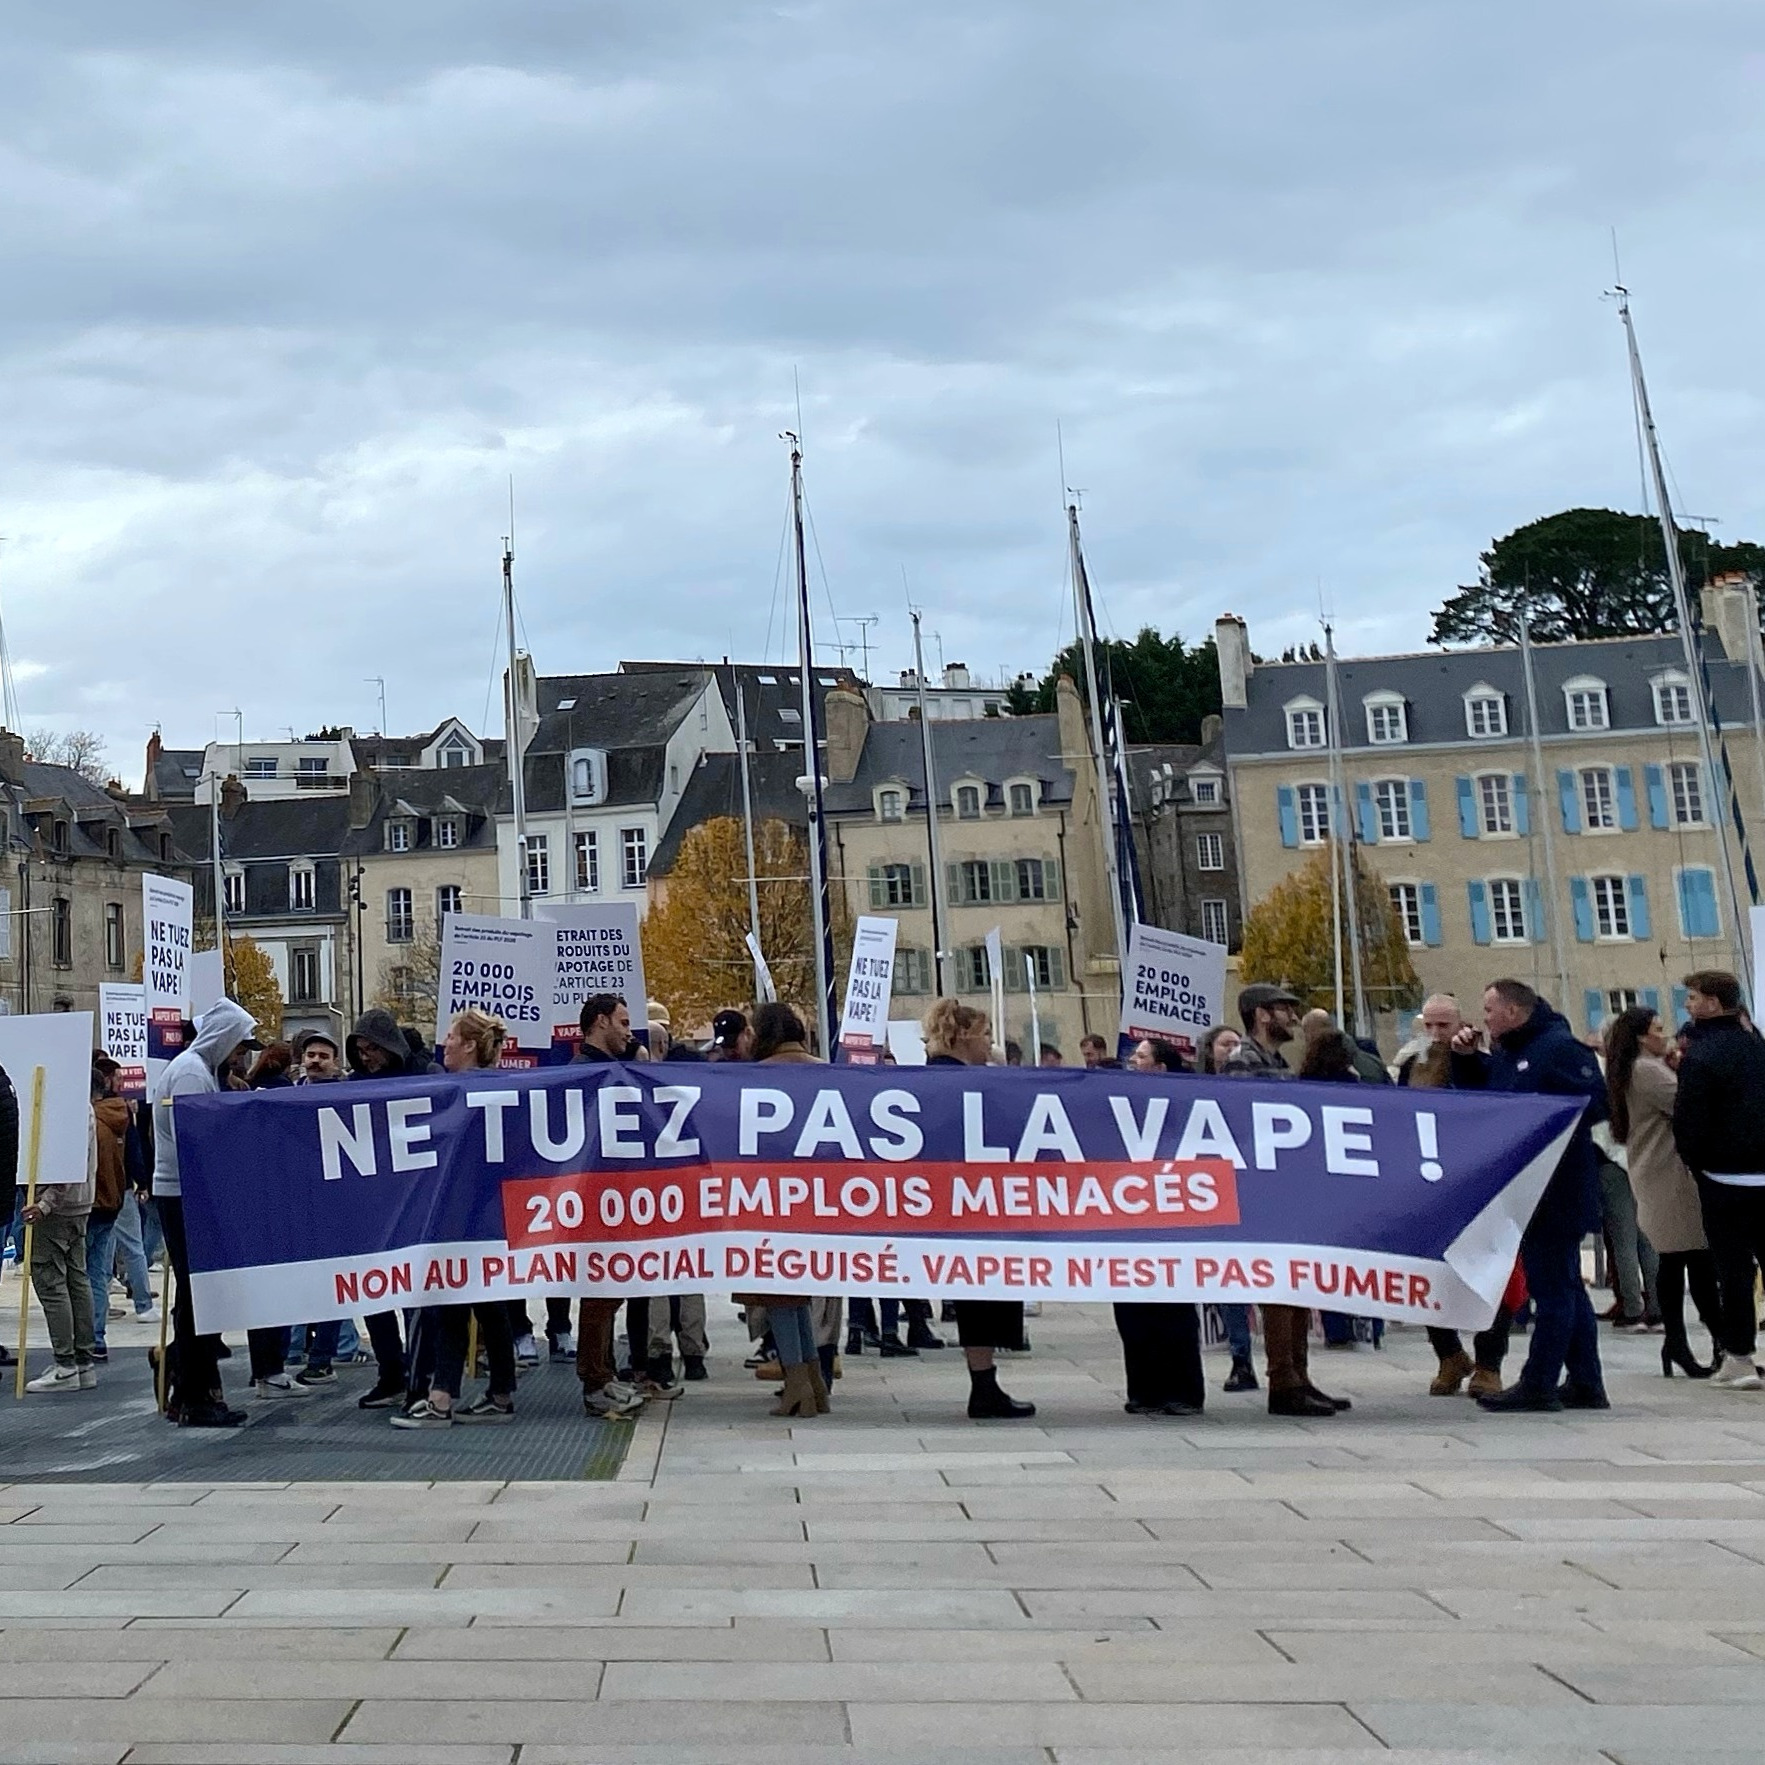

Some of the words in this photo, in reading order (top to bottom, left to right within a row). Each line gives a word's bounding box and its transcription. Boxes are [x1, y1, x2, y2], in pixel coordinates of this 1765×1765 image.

[151, 920, 166, 942] NE
[168, 923, 189, 949] TUEZ
[556, 929, 597, 942] ETRAIT
[600, 928, 623, 941] DES
[152, 945, 173, 968] PAS
[174, 950, 184, 972] LA
[557, 945, 610, 957] RODUITS
[613, 944, 630, 956] DU
[453, 961, 474, 976] 20
[480, 963, 514, 980] 000
[555, 960, 614, 973] APOTAGE
[617, 960, 633, 972] DE
[855, 957, 869, 976] NE
[869, 958, 889, 979] TUEZ
[1137, 965, 1156, 979] 20
[1161, 970, 1190, 988] 000
[452, 979, 534, 1001] EMPLOIS
[553, 976, 608, 989] 'ARTICLE
[611, 976, 624, 988] 23
[852, 979, 869, 998] PAS
[871, 982, 882, 1000] LA
[553, 992, 569, 1004] DU
[1136, 980, 1206, 1009] EMPLOIS
[107, 1012, 122, 1025] NE
[124, 1012, 146, 1026] TUE
[108, 1028, 130, 1041] PAS
[132, 1029, 146, 1042] LA
[558, 1026, 584, 1038] VAPE
[317, 1097, 438, 1181] NE
[466, 1086, 701, 1163] TUEZ
[739, 1088, 925, 1162] PAS
[963, 1091, 1085, 1163] LA
[1108, 1095, 1380, 1178] VAPE
[1415, 1112, 1444, 1182] !
[526, 1190, 584, 1234] 20
[600, 1184, 684, 1228] 000
[699, 1176, 934, 1218] EMPLOIS
[951, 1163, 1220, 1217] MENACÉS
[335, 1262, 412, 1305] NON
[424, 1258, 468, 1292] AU
[482, 1251, 577, 1288] PLAN
[587, 1247, 714, 1282] SOCIAL
[725, 1238, 910, 1284] DÉGUISÉ.
[922, 1254, 1053, 1288] VAPER
[1067, 1257, 1181, 1288] N'EST
[1195, 1257, 1275, 1289] PAS
[1290, 1260, 1442, 1311] FUMER.
